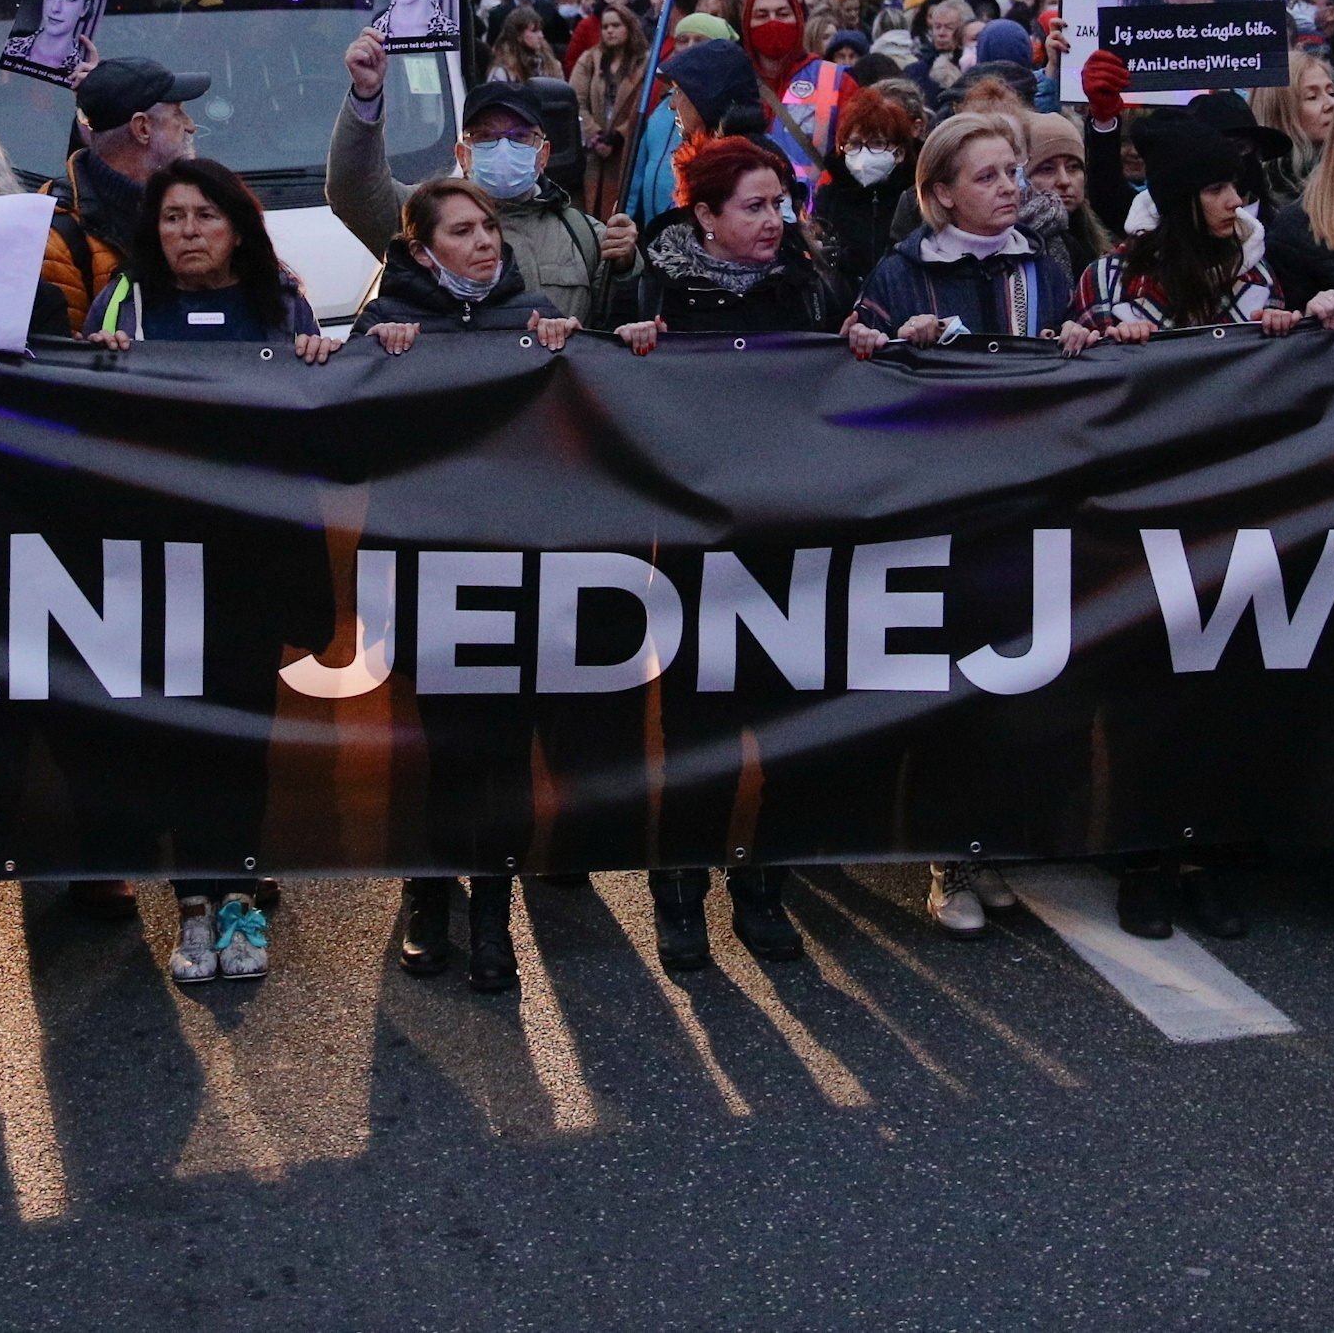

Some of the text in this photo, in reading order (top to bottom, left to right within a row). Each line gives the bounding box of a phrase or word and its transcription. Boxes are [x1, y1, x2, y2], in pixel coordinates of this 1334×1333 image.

[1110, 22, 1277, 46] Jej serce też ciągle biło.
[1127, 54, 1261, 73] #AniJednejWięcej
[278, 528, 1072, 699] JEDNEJ
